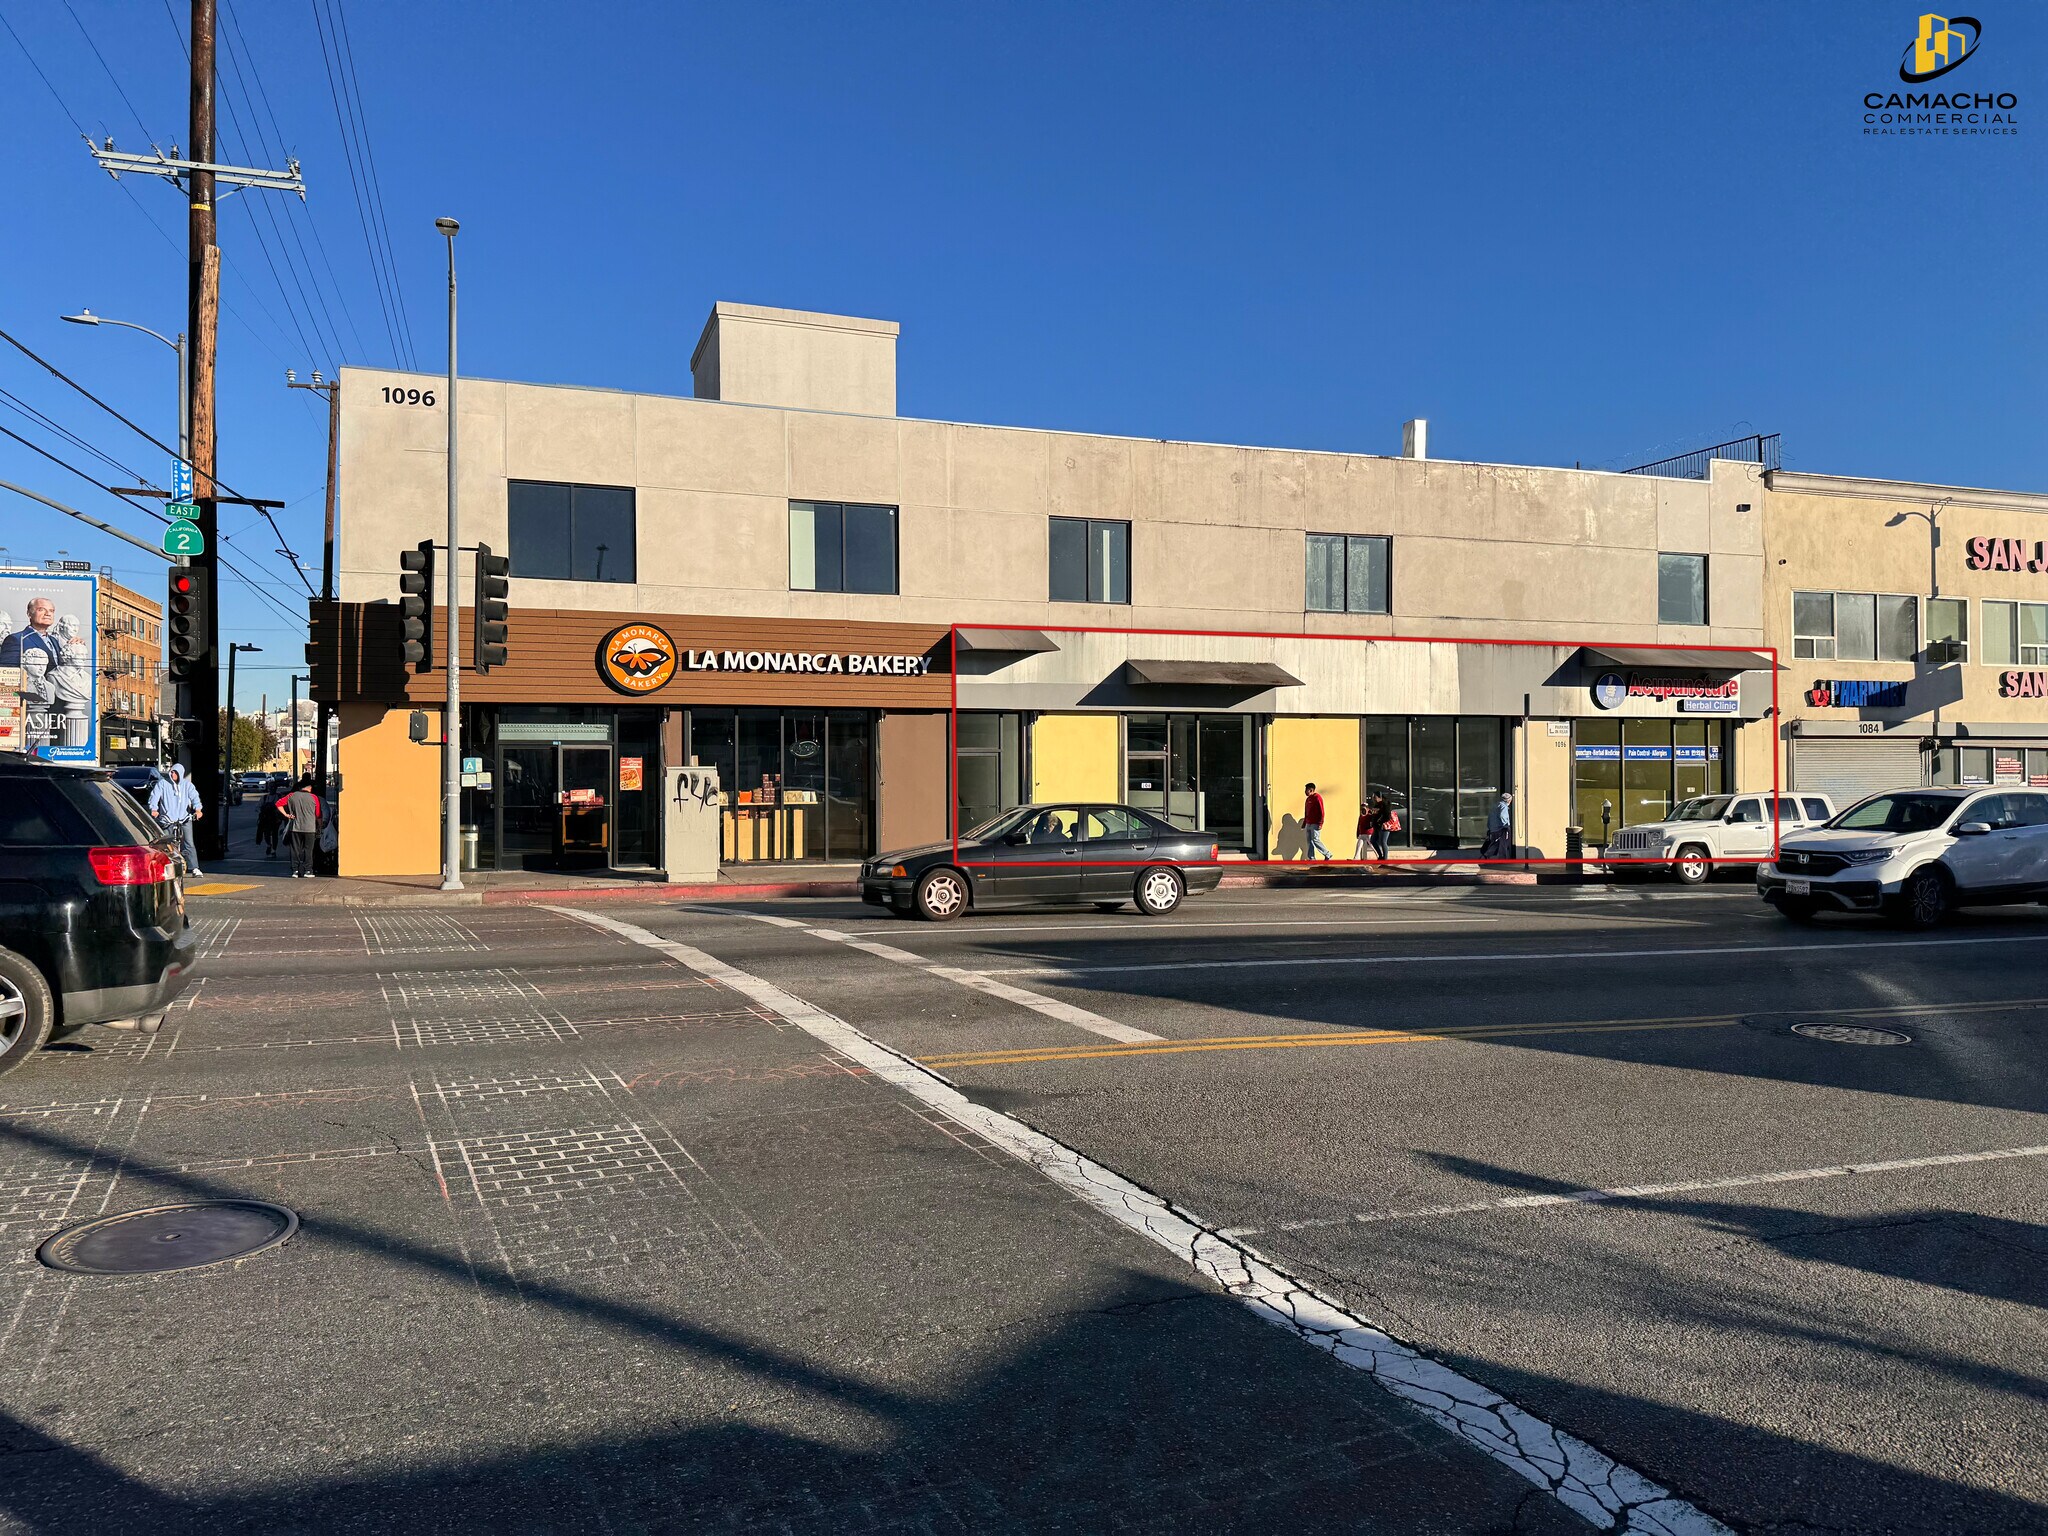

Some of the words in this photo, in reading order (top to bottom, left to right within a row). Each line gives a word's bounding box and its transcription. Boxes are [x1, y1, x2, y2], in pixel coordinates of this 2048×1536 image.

[381, 386, 436, 407] 1096
[170, 505, 195, 516] EAST
[168, 526, 198, 534] CALIFORNIA
[177, 533, 190, 550] 2
[1971, 535, 2028, 571] SAN
[611, 639, 622, 652] LA
[621, 628, 669, 651] MONARCA
[688, 649, 719, 670] LA
[723, 650, 843, 675] MONARCA
[848, 654, 933, 676] BAKERY
[624, 673, 663, 688] BAKERY
[1628, 672, 1739, 699] Acupuncture
[2005, 671, 2048, 697] SAN
[1834, 680, 1908, 707] PHARMACY
[1685, 700, 1712, 710] Herbal
[1713, 701, 1737, 711] Clinic
[1858, 723, 1879, 734] 1084
[466, 761, 475, 770] A
